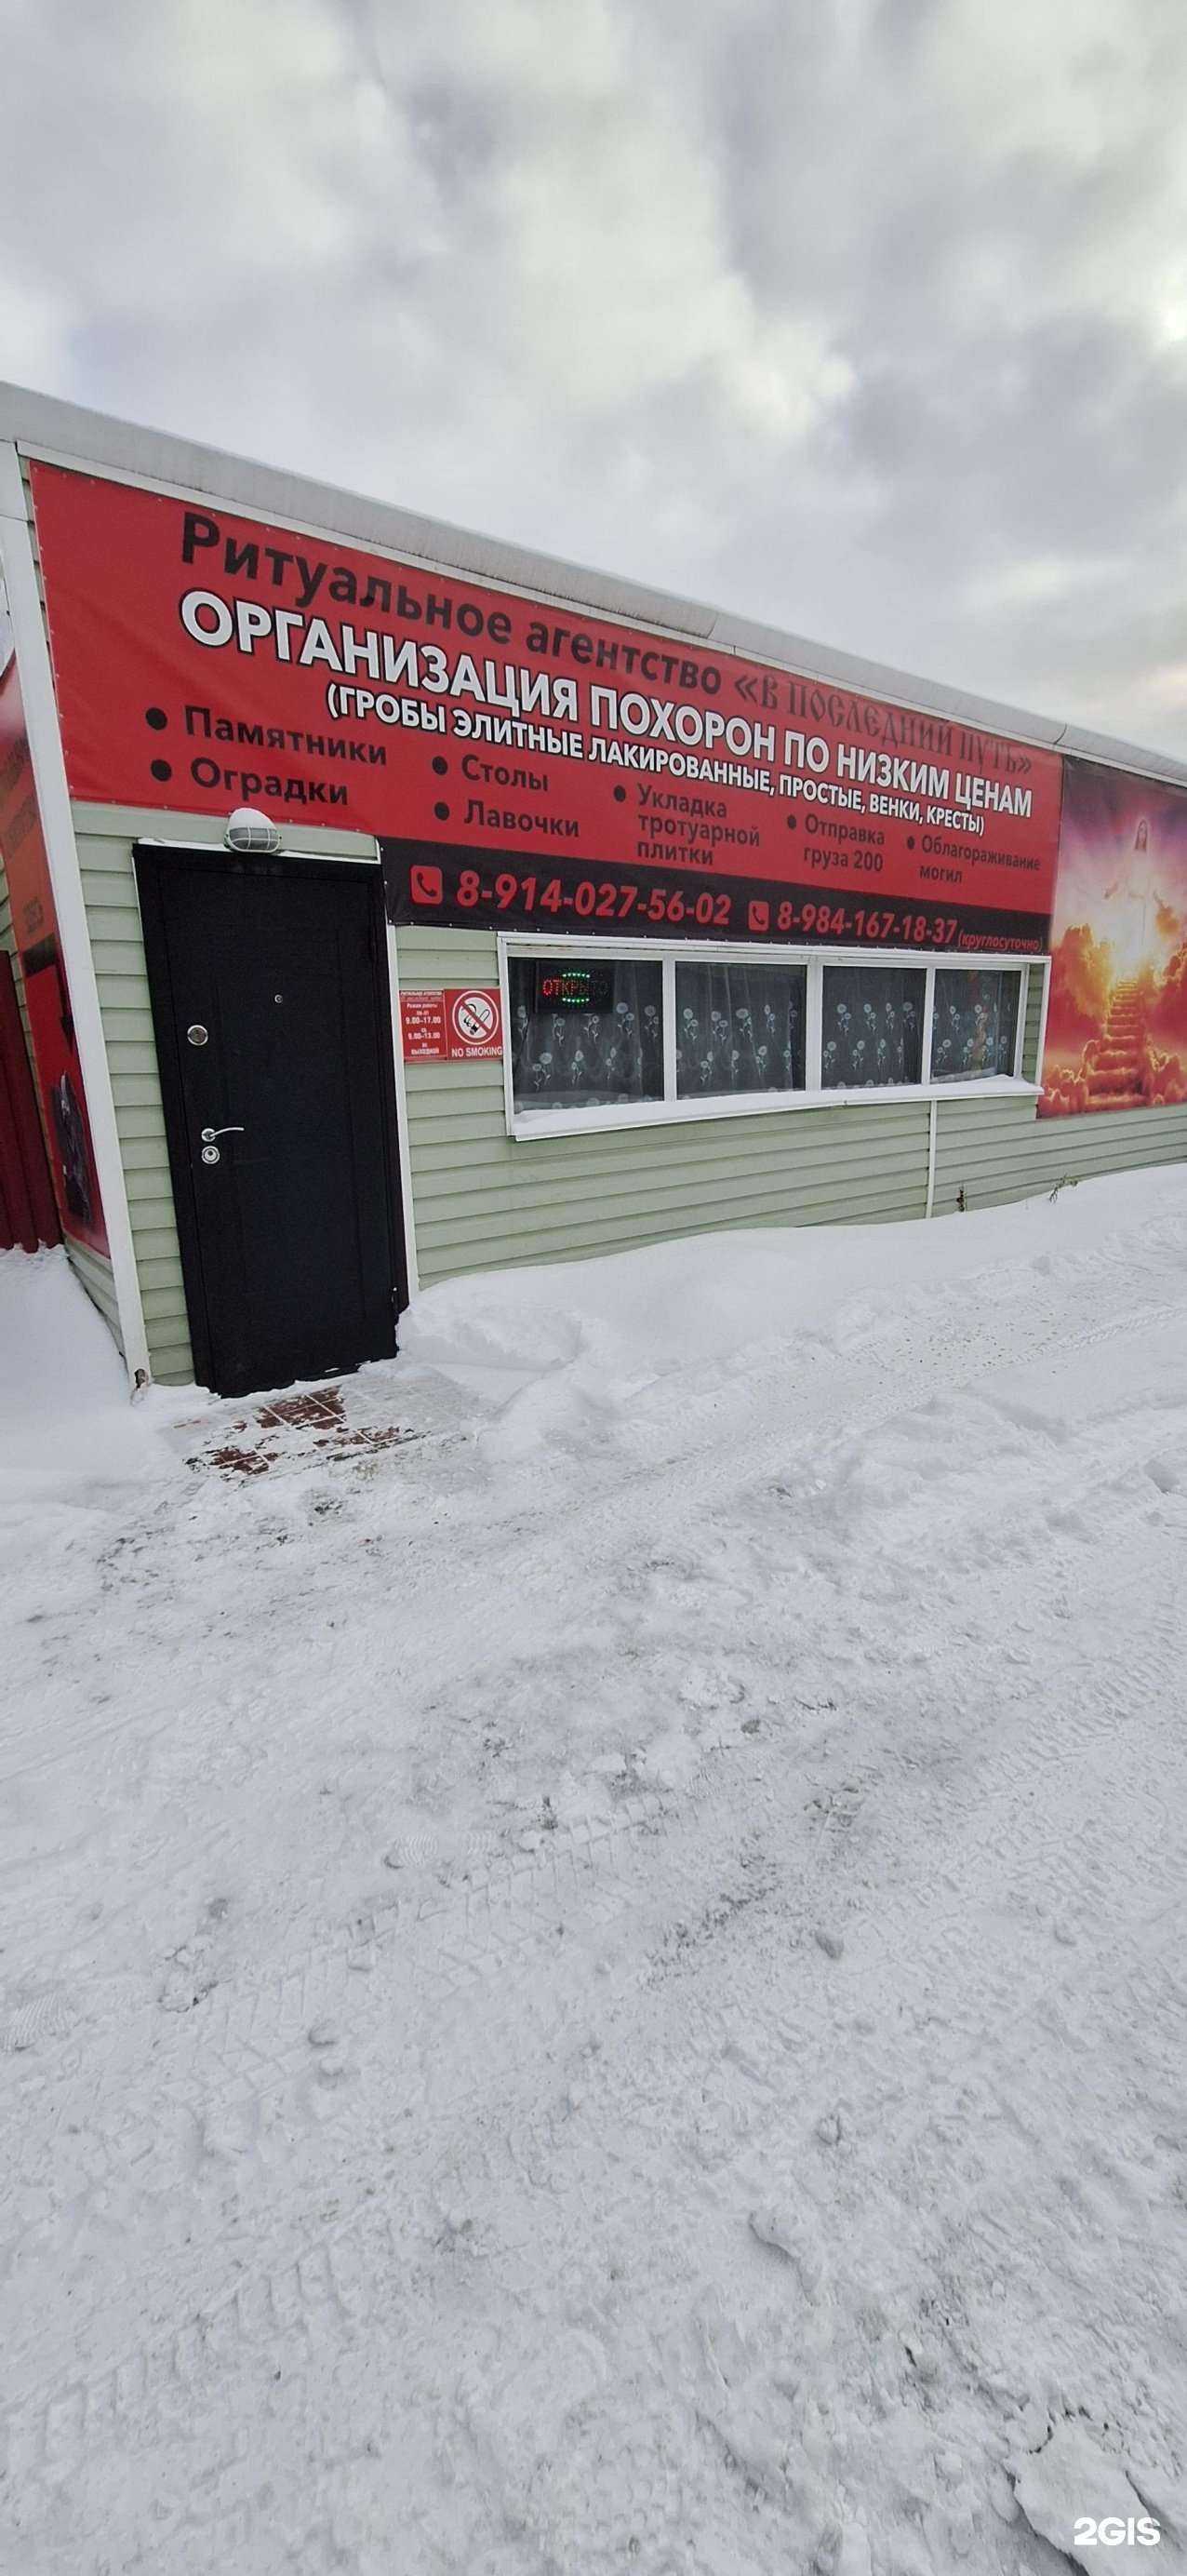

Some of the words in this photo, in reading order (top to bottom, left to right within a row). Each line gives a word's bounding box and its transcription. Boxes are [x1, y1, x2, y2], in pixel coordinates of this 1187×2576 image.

[181, 511, 512, 644] Ритуальное
[526, 621, 722, 694] агентство
[787, 679, 953, 756] ПОСЛЕДНИЙ
[180, 588, 578, 723] ОРГАНИЗАЦИЯ
[590, 684, 776, 763] ПОХОРОН
[784, 729, 831, 774] ПО
[836, 743, 949, 801] НИЗКИМ
[954, 771, 1033, 818] ЦЕНАМ
[185, 705, 387, 766] Памятники
[327, 681, 447, 735] (ГРОБЫ
[452, 708, 584, 760] ЭЛИТНЫЕ
[588, 736, 775, 796] ЛАКИРОВАННЫЕ,
[779, 771, 866, 813] ПРОСТЫЕ,
[869, 793, 924, 825] ВЕНКИ,
[926, 806, 985, 837] КРЕСТЫ)
[461, 754, 548, 792] Столы
[191, 757, 349, 806] Оградки
[464, 799, 580, 839] Лавочки
[637, 782, 727, 819] Укладка
[638, 813, 760, 847] тротуарной
[805, 813, 886, 846] Отправка
[636, 841, 714, 865] плитки
[804, 846, 849, 870] груза
[853, 851, 884, 872] 200
[921, 835, 1041, 871] Облагораживание
[919, 864, 963, 883] могил
[456, 869, 733, 925] 8-914-027-56-02
[777, 900, 957, 945] 8-984-167-18-37
[957, 928, 1043, 951] (круглосуточно)
[451, 1048, 464, 1057] NO
[465, 1046, 502, 1056] SMOKING
